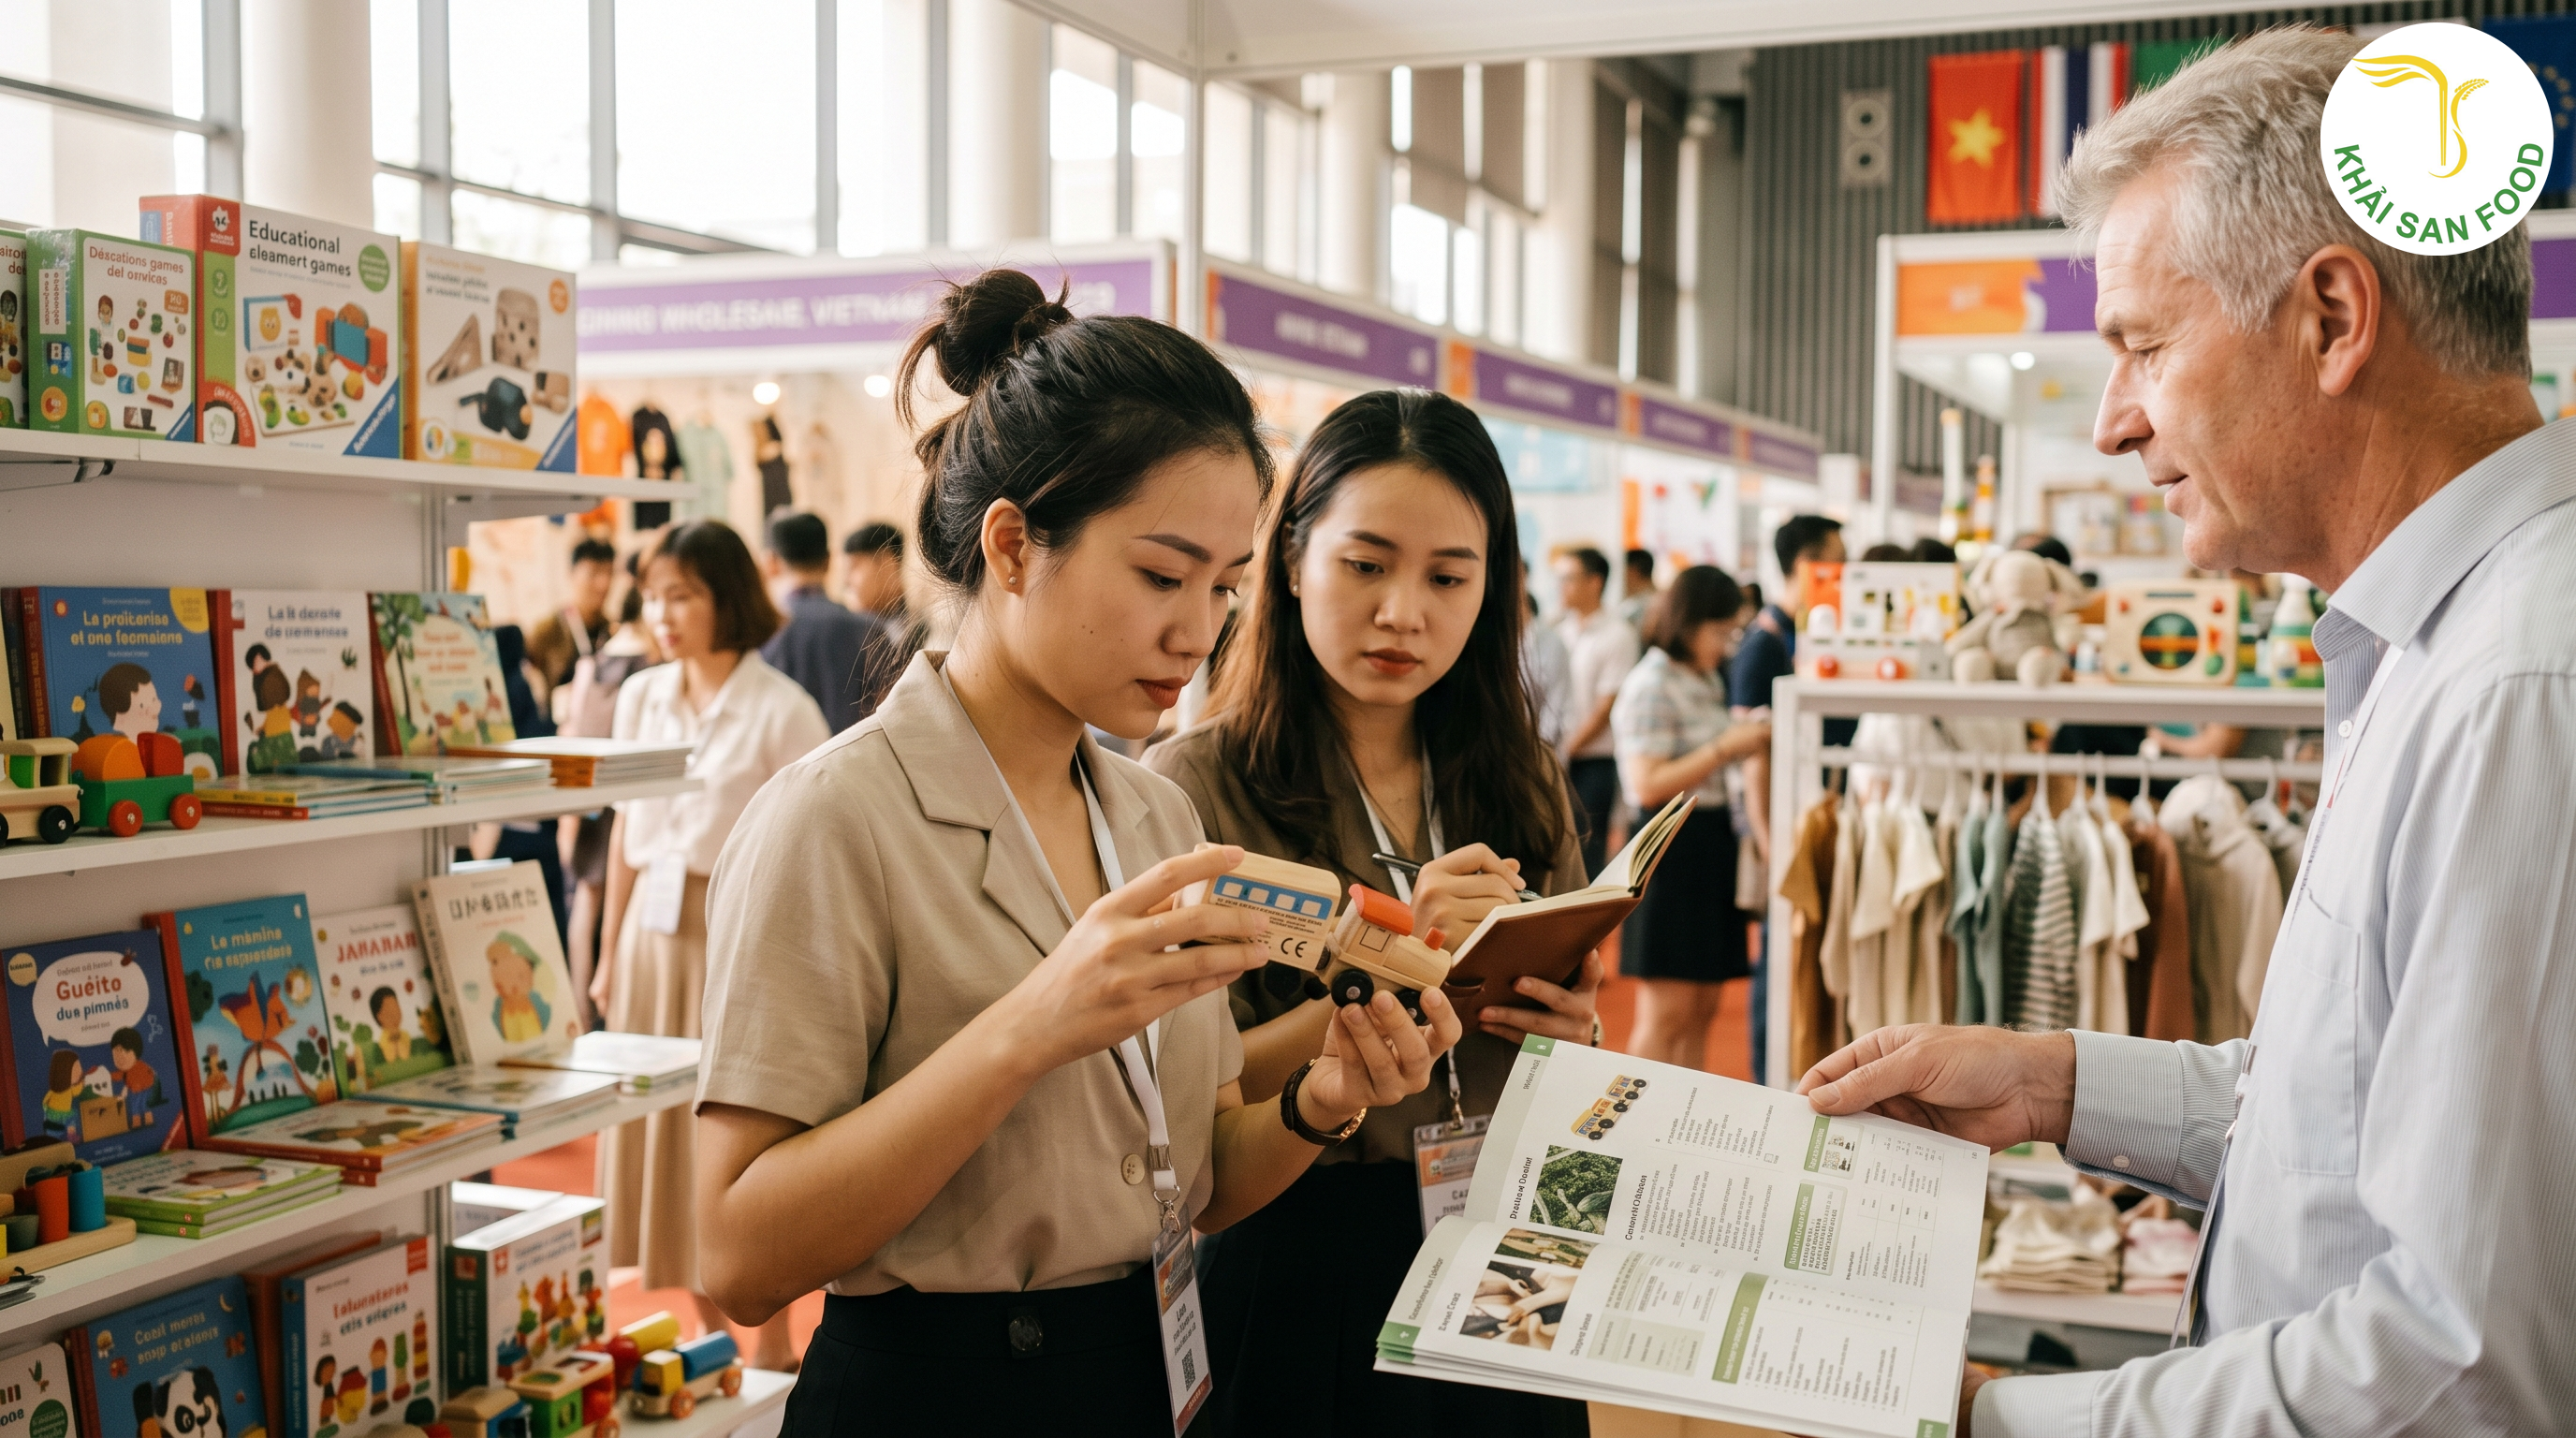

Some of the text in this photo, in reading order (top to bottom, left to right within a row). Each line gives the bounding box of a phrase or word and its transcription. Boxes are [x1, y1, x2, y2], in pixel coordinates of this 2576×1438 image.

[249, 220, 340, 254] Educational
[150, 259, 183, 273] games
[310, 259, 351, 277] games
[1281, 937, 1308, 958] CE
